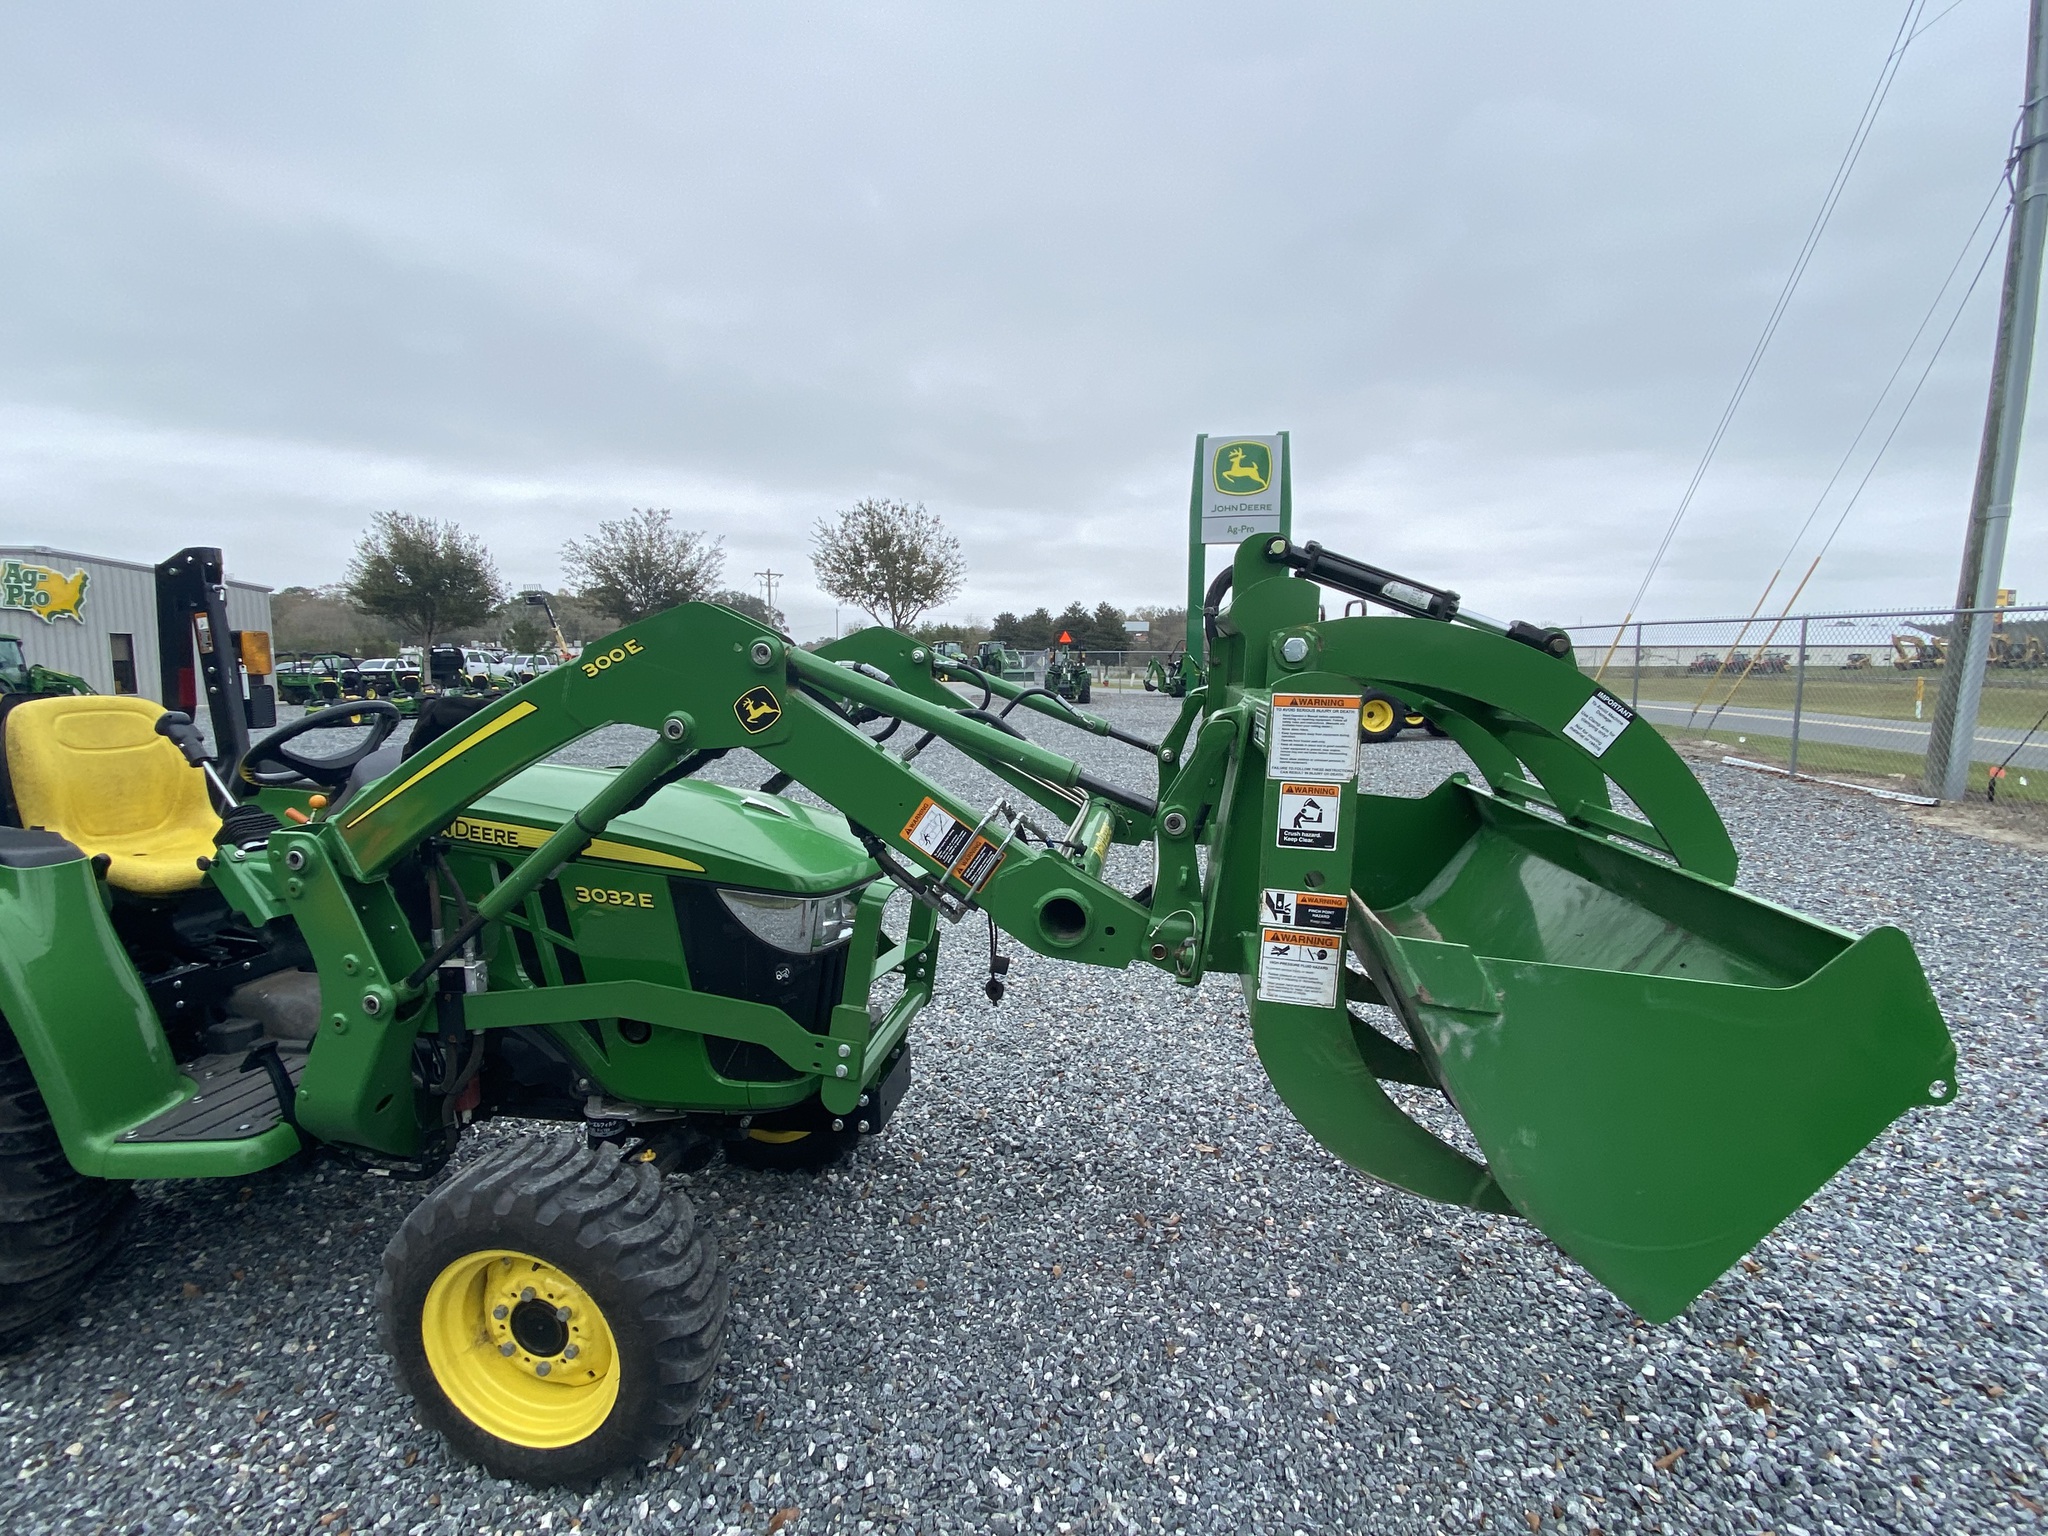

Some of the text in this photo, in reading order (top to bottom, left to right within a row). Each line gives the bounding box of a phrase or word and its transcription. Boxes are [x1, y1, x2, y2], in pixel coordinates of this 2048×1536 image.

[1211, 503, 1272, 513] JOHN DEERE
[1227, 525, 1255, 535] Ag-Pro
[6, 585, 50, 606] Pro
[1298, 698, 1345, 707] WARNING
[1597, 692, 1633, 718] IMPORTANT
[1294, 785, 1335, 795] WARNING
[910, 802, 929, 828] WARNING
[455, 820, 519, 845] DEERE
[962, 841, 981, 866] WARNING
[574, 886, 655, 908] 3032E
[1307, 897, 1343, 906] WARNING
[1280, 933, 1333, 947] WARNING
